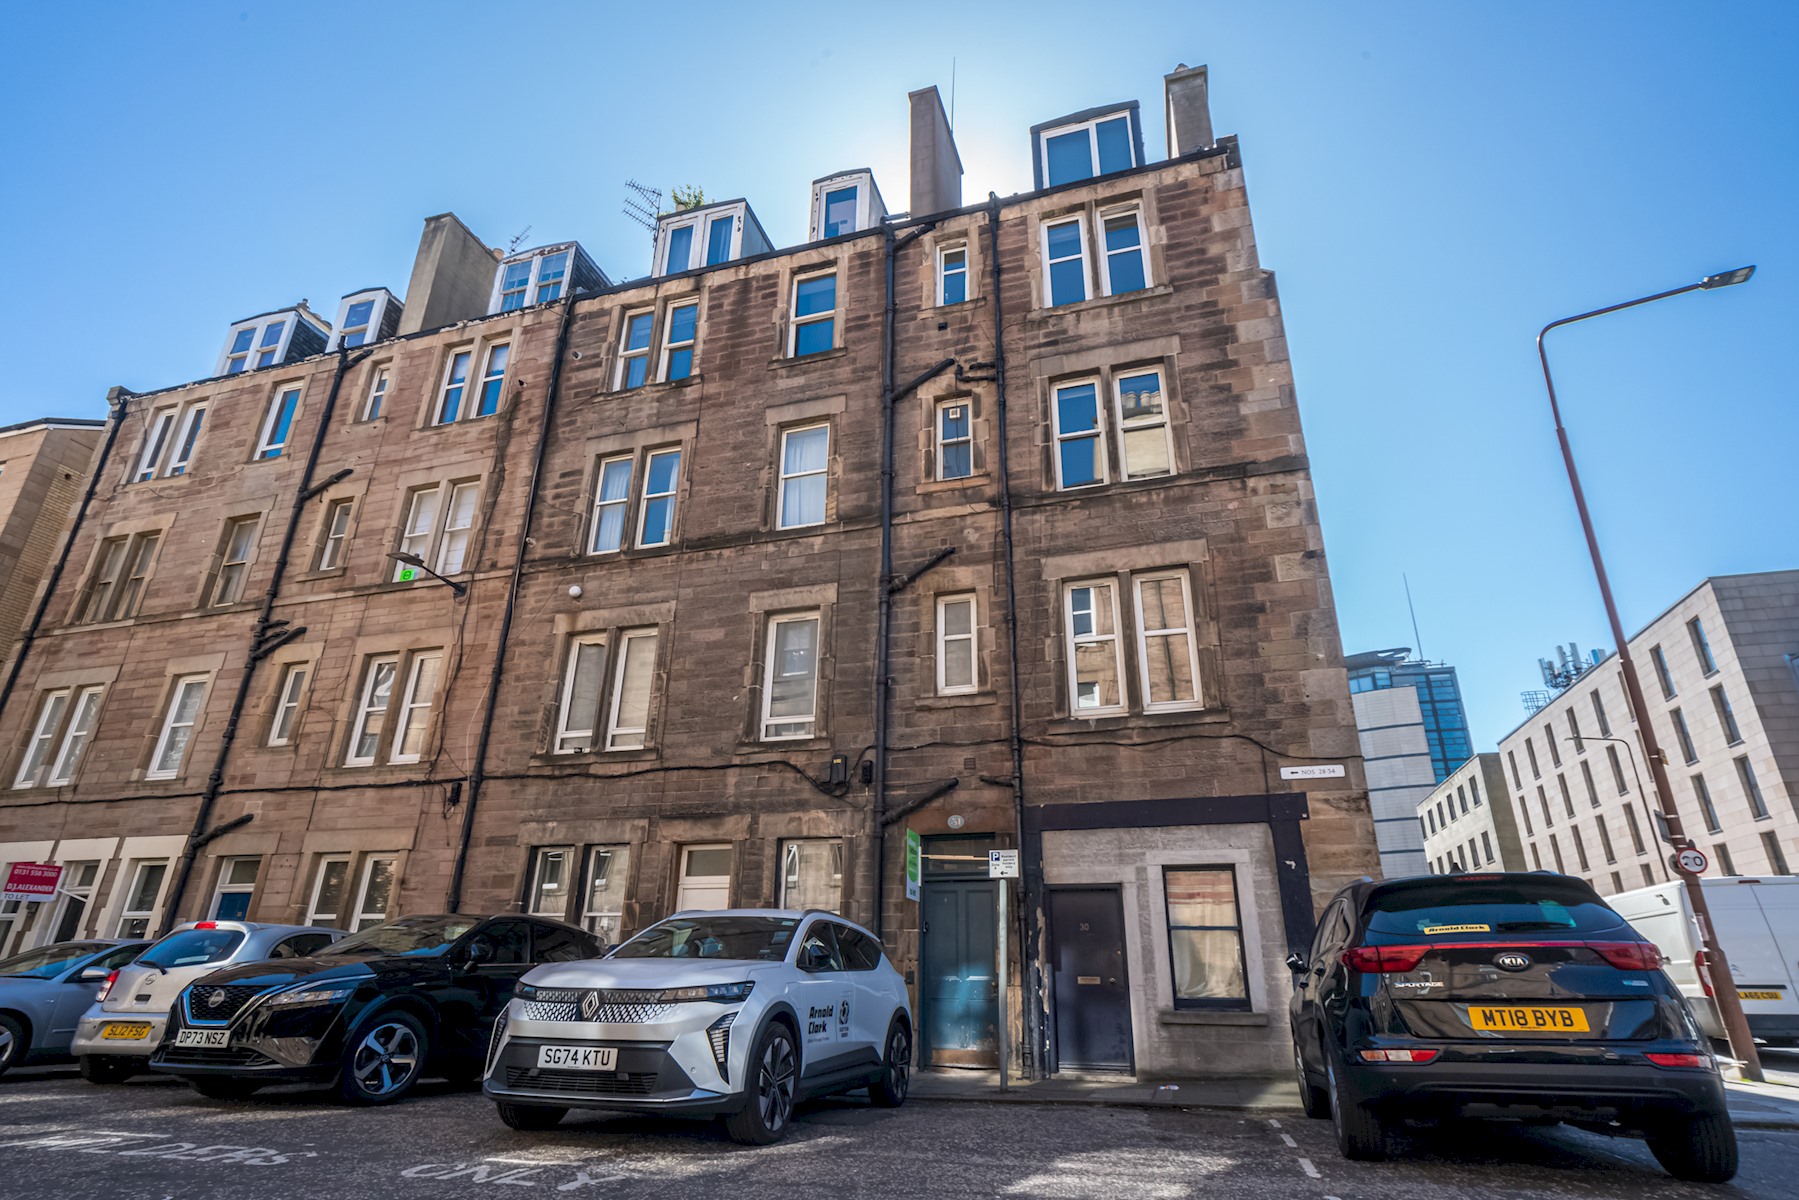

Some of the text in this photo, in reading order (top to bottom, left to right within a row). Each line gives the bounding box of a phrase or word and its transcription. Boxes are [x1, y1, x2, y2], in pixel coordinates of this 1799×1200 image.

[992, 852, 999, 860] P
[1503, 957, 1524, 966] KIA
[809, 1005, 834, 1019] Arnold
[1481, 1009, 1574, 1027] MT18 BYB
[108, 1023, 127, 1036] SL12
[808, 1021, 827, 1034] Clark
[179, 1031, 226, 1045] DP73 NSZ
[544, 1048, 611, 1066] SG74 KTU
